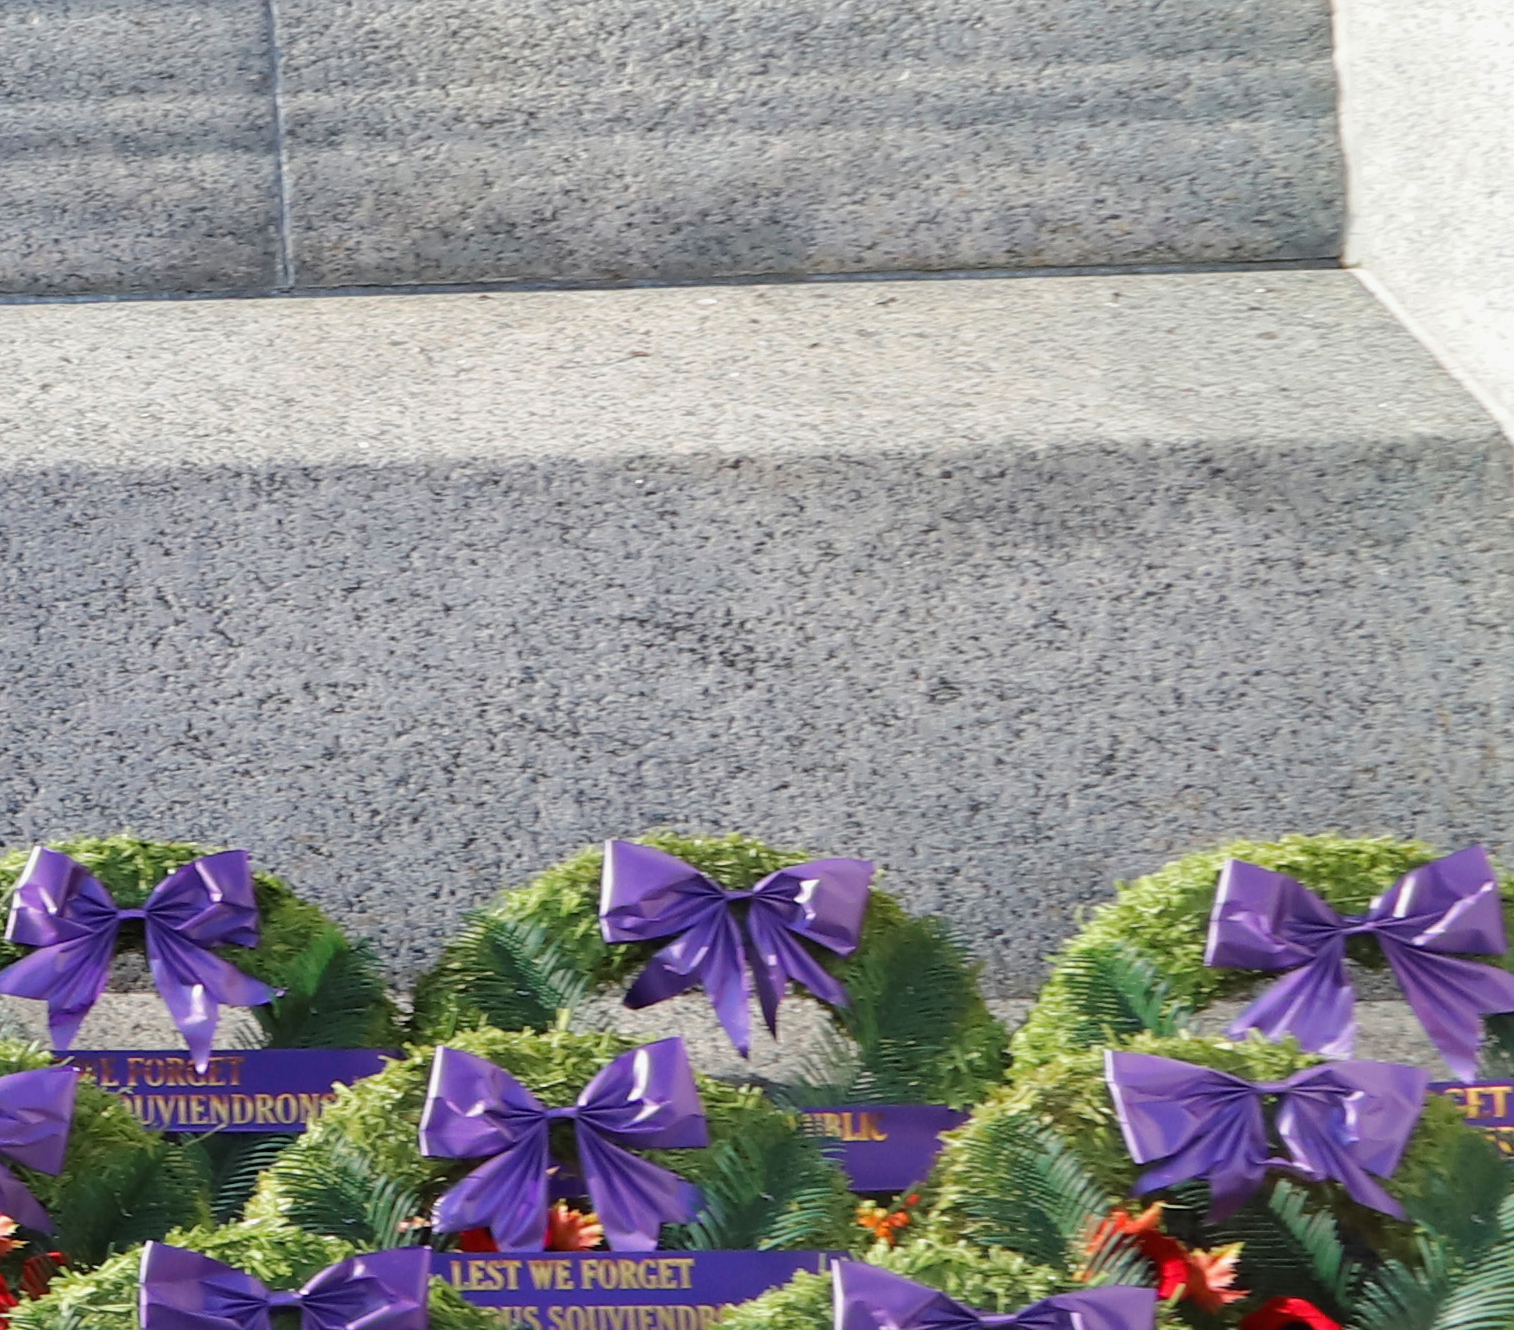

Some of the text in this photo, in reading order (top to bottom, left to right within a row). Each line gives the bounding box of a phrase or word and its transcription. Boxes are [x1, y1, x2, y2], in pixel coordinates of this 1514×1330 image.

[127, 1056, 245, 1087] FORGET
[451, 1257, 695, 1291] LEST WE FORGET
